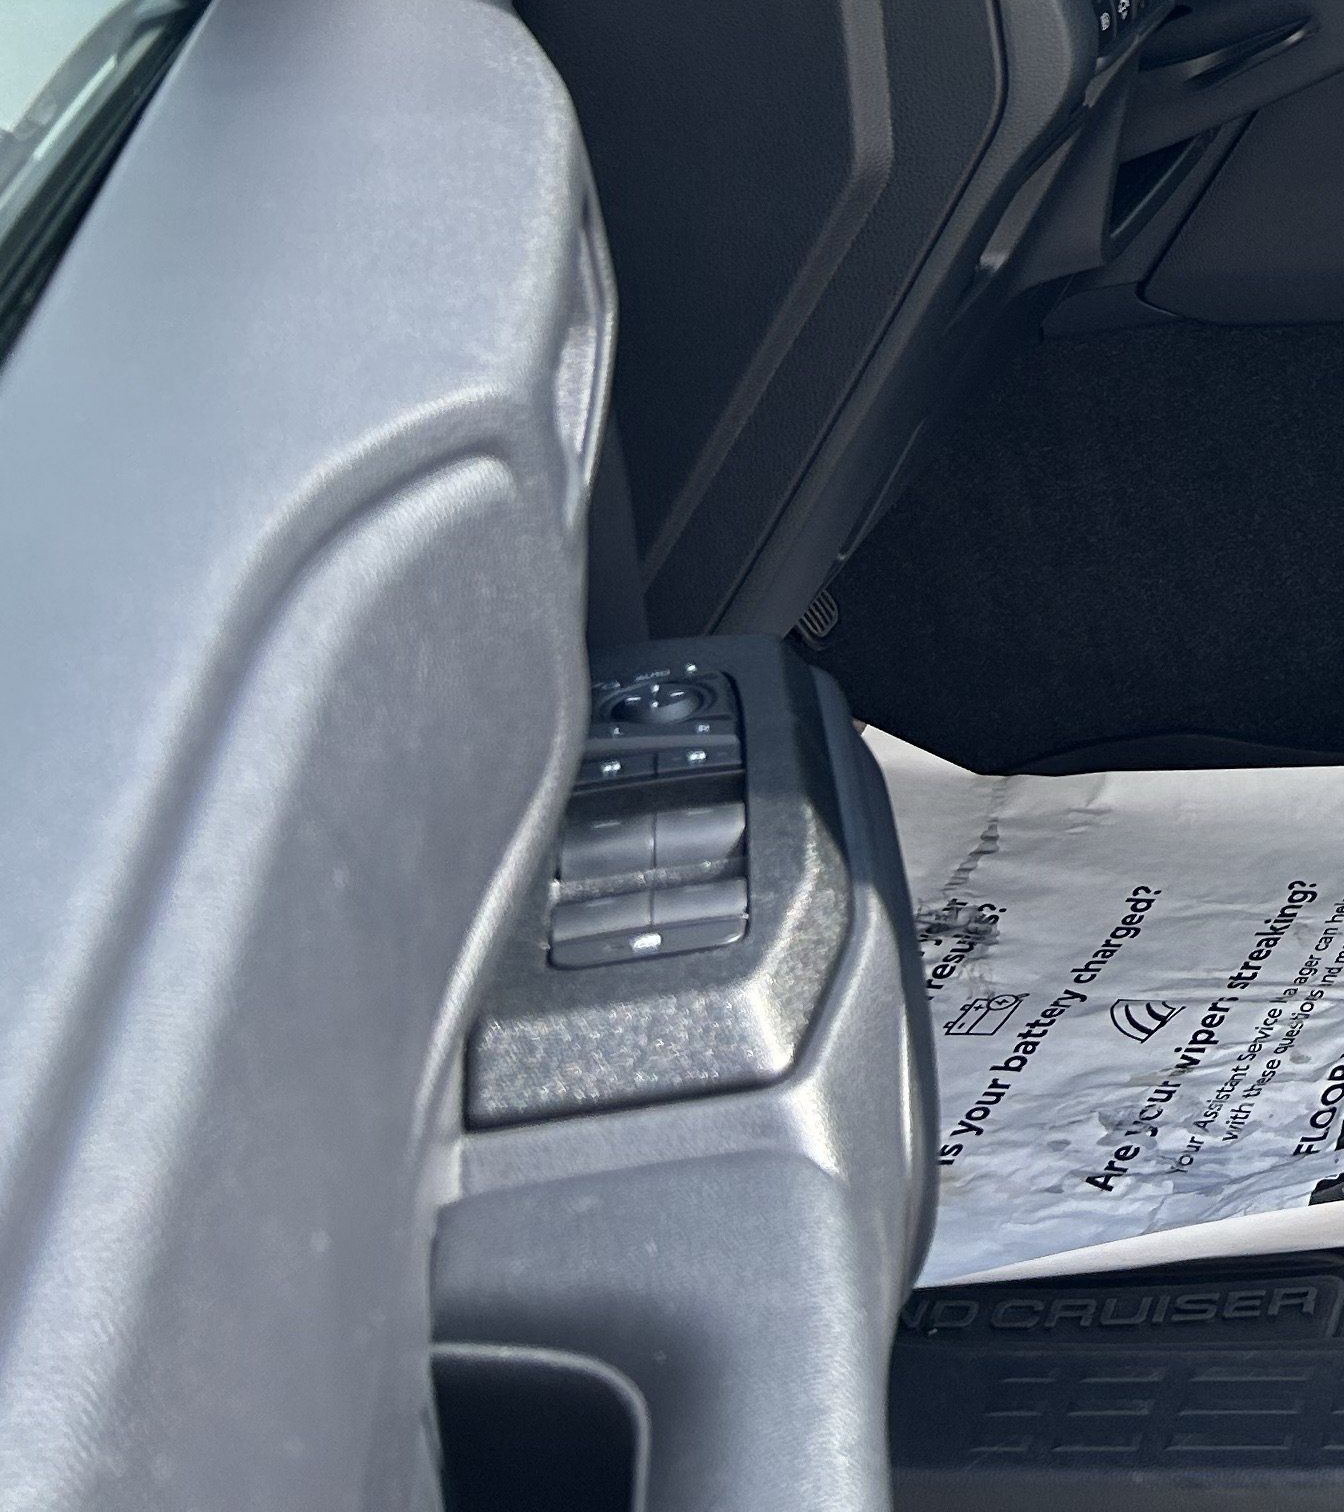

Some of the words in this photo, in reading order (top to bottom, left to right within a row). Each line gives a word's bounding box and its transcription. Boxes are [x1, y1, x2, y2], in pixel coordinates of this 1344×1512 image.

[950, 1077, 1012, 1137] your
[989, 989, 1089, 1073] battery
[1070, 885, 1163, 985] charged?
[1085, 1143, 1140, 1192] Are
[1227, 880, 1319, 990] streaking?
[1193, 1064, 1250, 1134] Assistant
[1237, 1006, 1283, 1062] Service
[1314, 921, 1340, 952] can
[1222, 1102, 1254, 1143] with
[990, 1285, 1319, 1331] CRUISER
